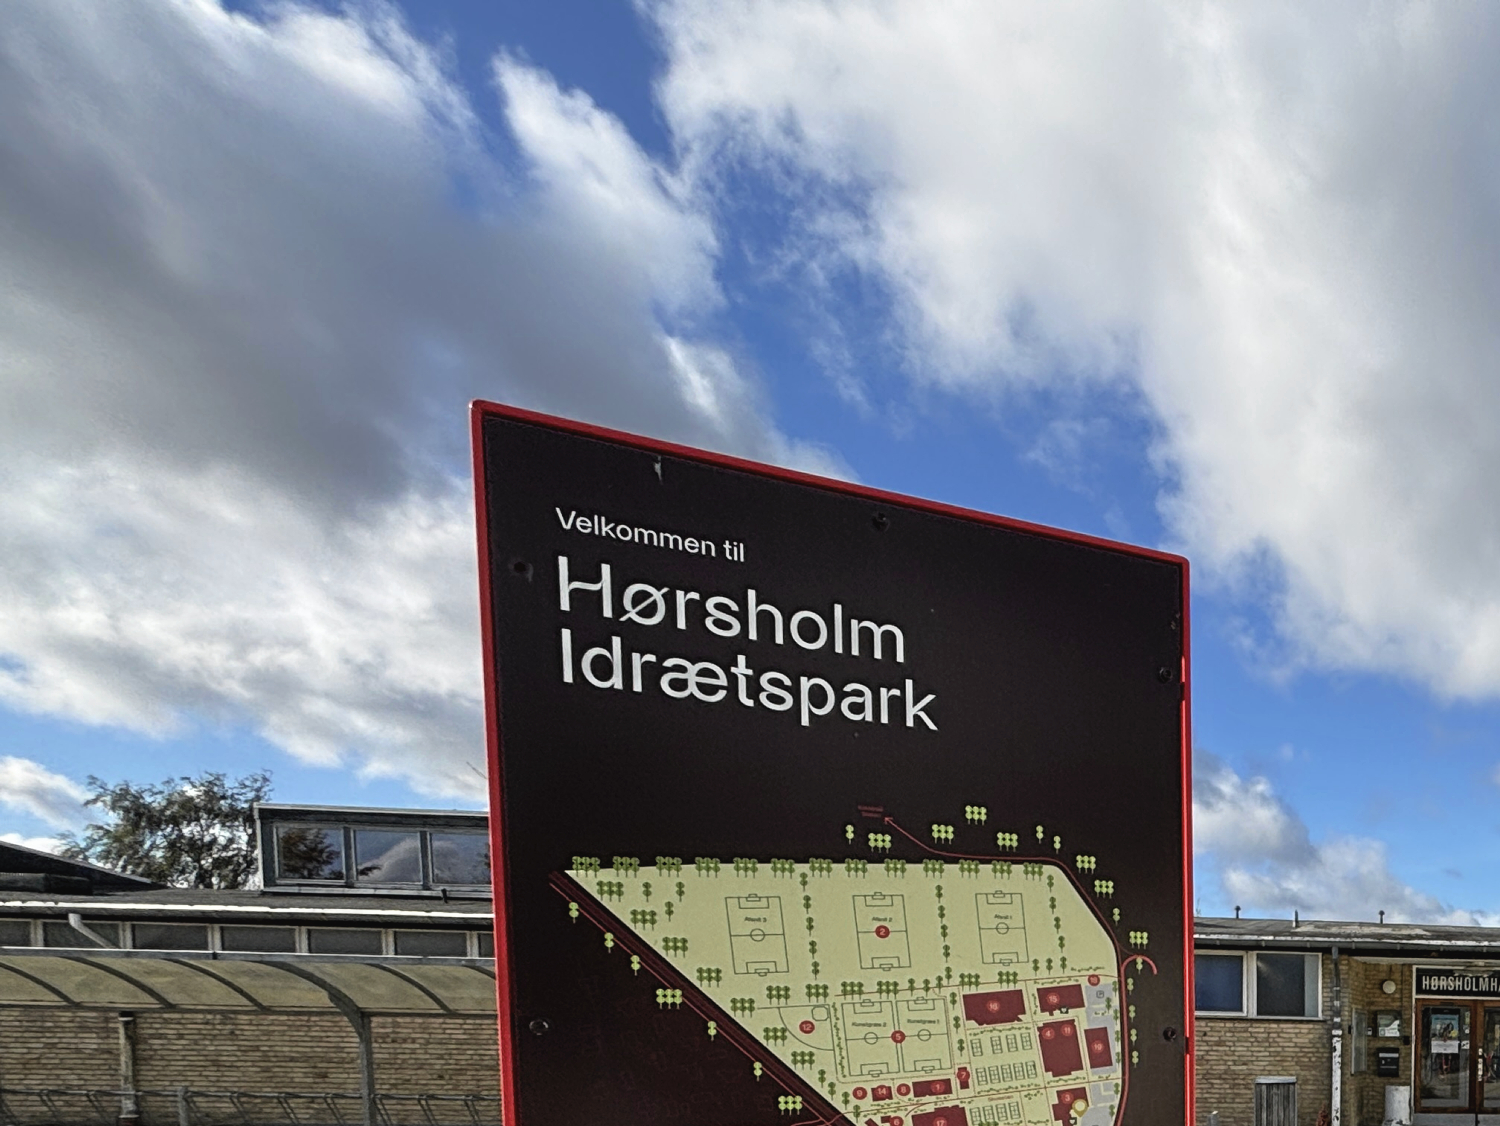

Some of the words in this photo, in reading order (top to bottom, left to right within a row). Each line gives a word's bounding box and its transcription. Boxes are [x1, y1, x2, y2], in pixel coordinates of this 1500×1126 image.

[555, 507, 716, 557] Velkommen
[724, 538, 746, 562] til
[557, 556, 905, 662] Hørsholm
[561, 628, 938, 731] Idrætspark
[879, 927, 886, 936] 2
[802, 1023, 813, 1031] 12
[895, 1033, 902, 1041] 5
[877, 1086, 887, 1096] 14
